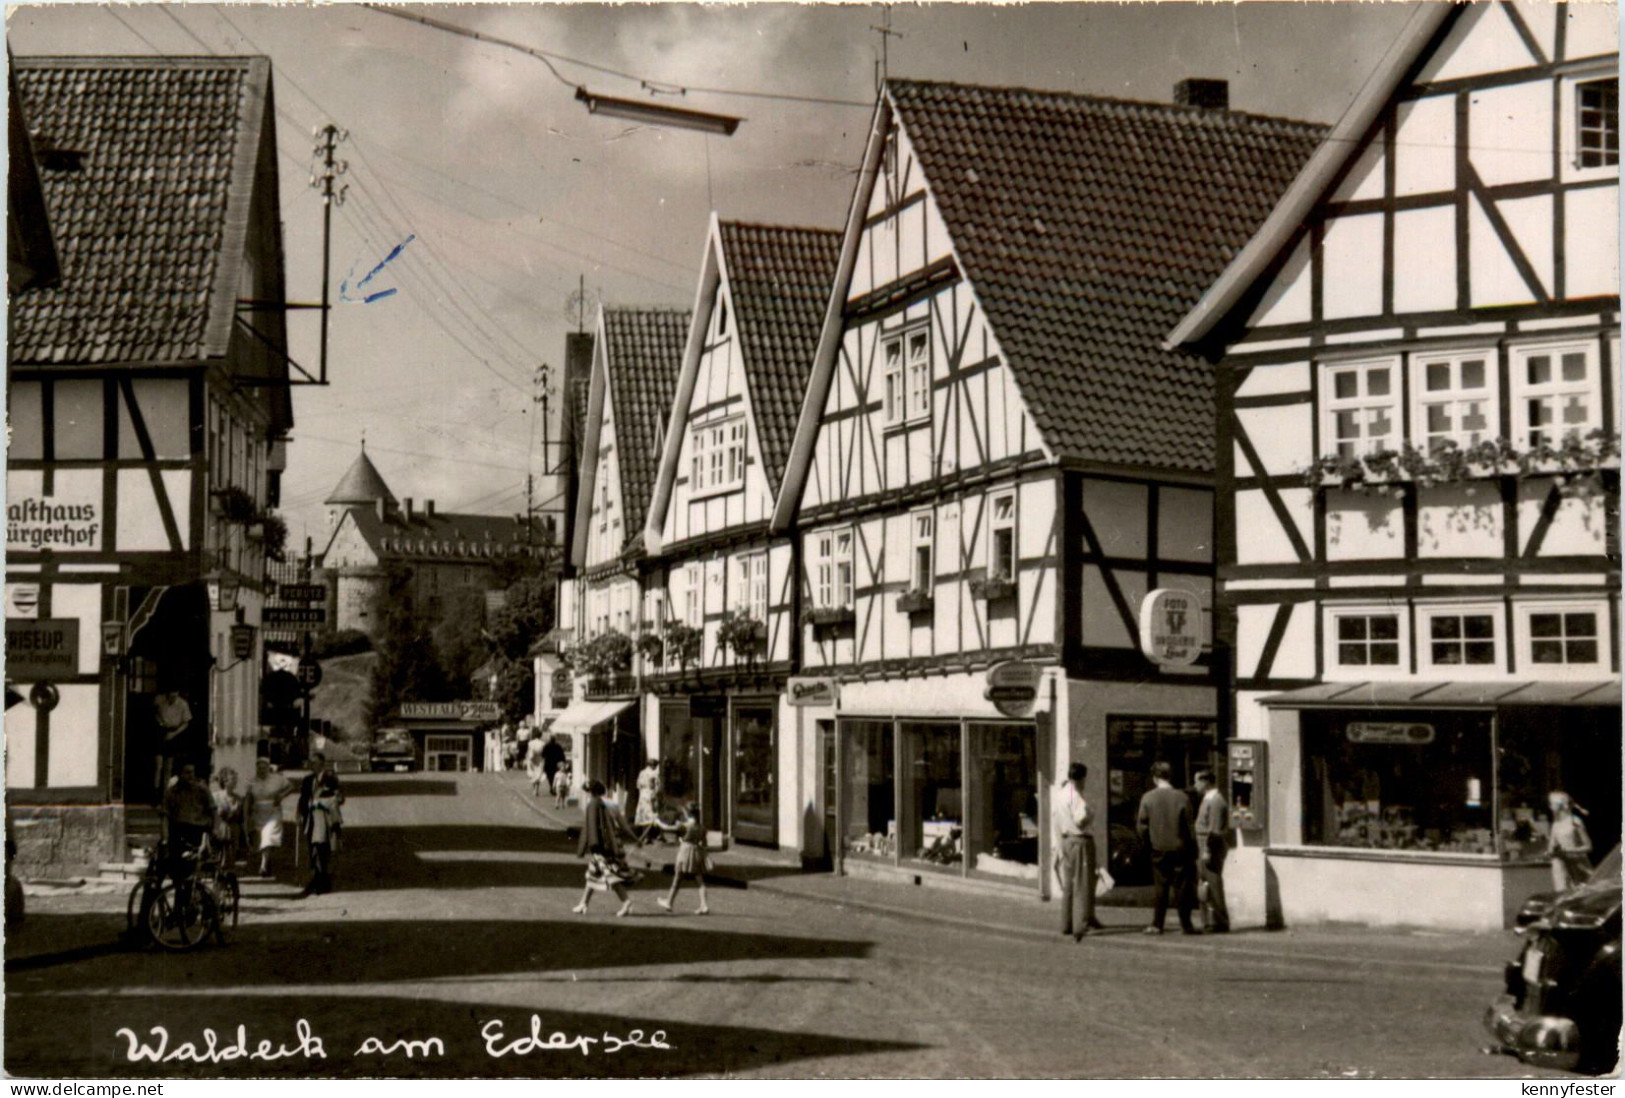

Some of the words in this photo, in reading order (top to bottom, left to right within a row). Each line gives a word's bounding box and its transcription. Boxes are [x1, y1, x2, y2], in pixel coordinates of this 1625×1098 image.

[6, 498, 95, 525] asthaus
[6, 523, 99, 549] ürgerhof
[1163, 598, 1188, 614] FOTO
